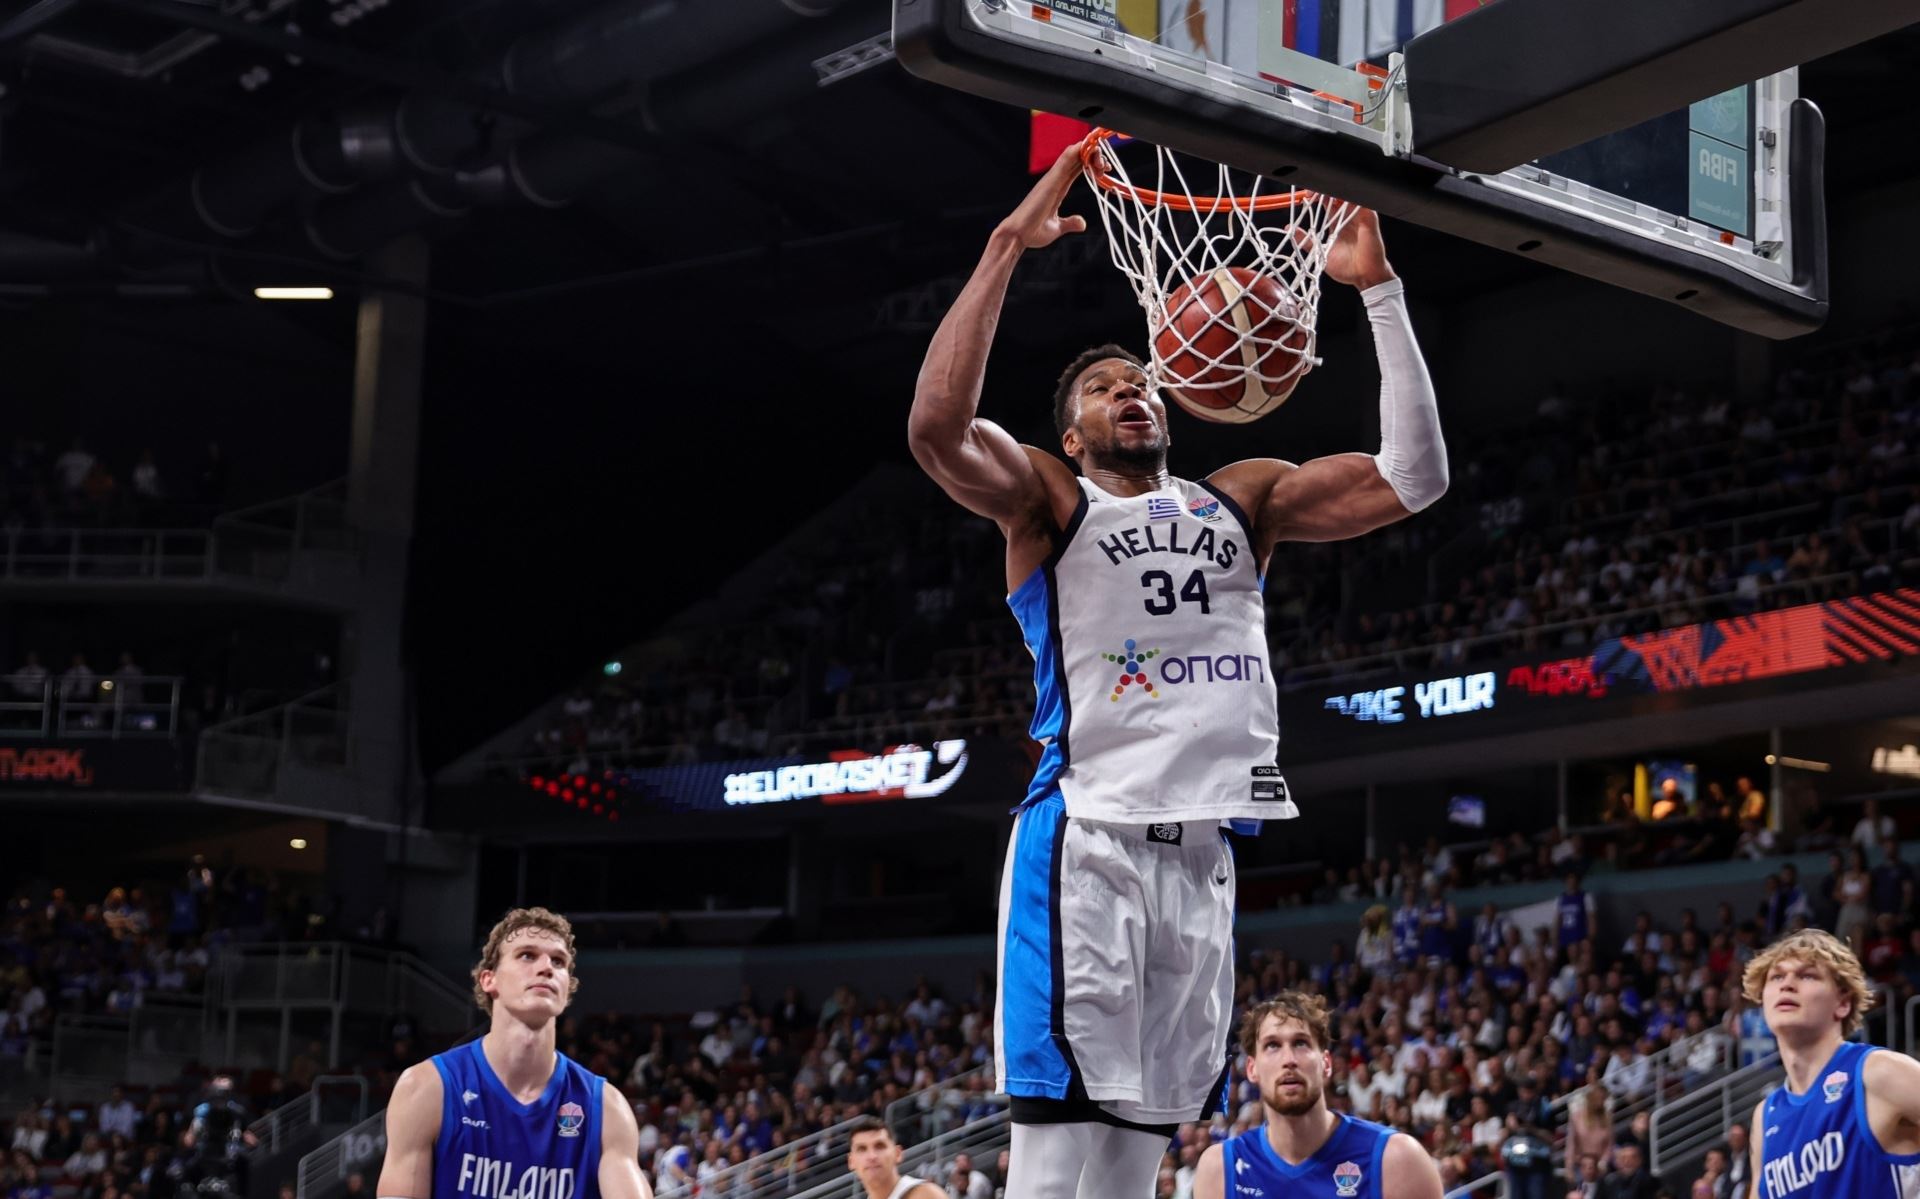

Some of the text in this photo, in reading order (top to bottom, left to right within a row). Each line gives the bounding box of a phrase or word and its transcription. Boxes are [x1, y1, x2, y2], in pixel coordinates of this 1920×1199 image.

[1097, 522, 1238, 570] HELLAS
[1141, 569, 1210, 616] 34
[1414, 672, 1495, 718] YOUR
